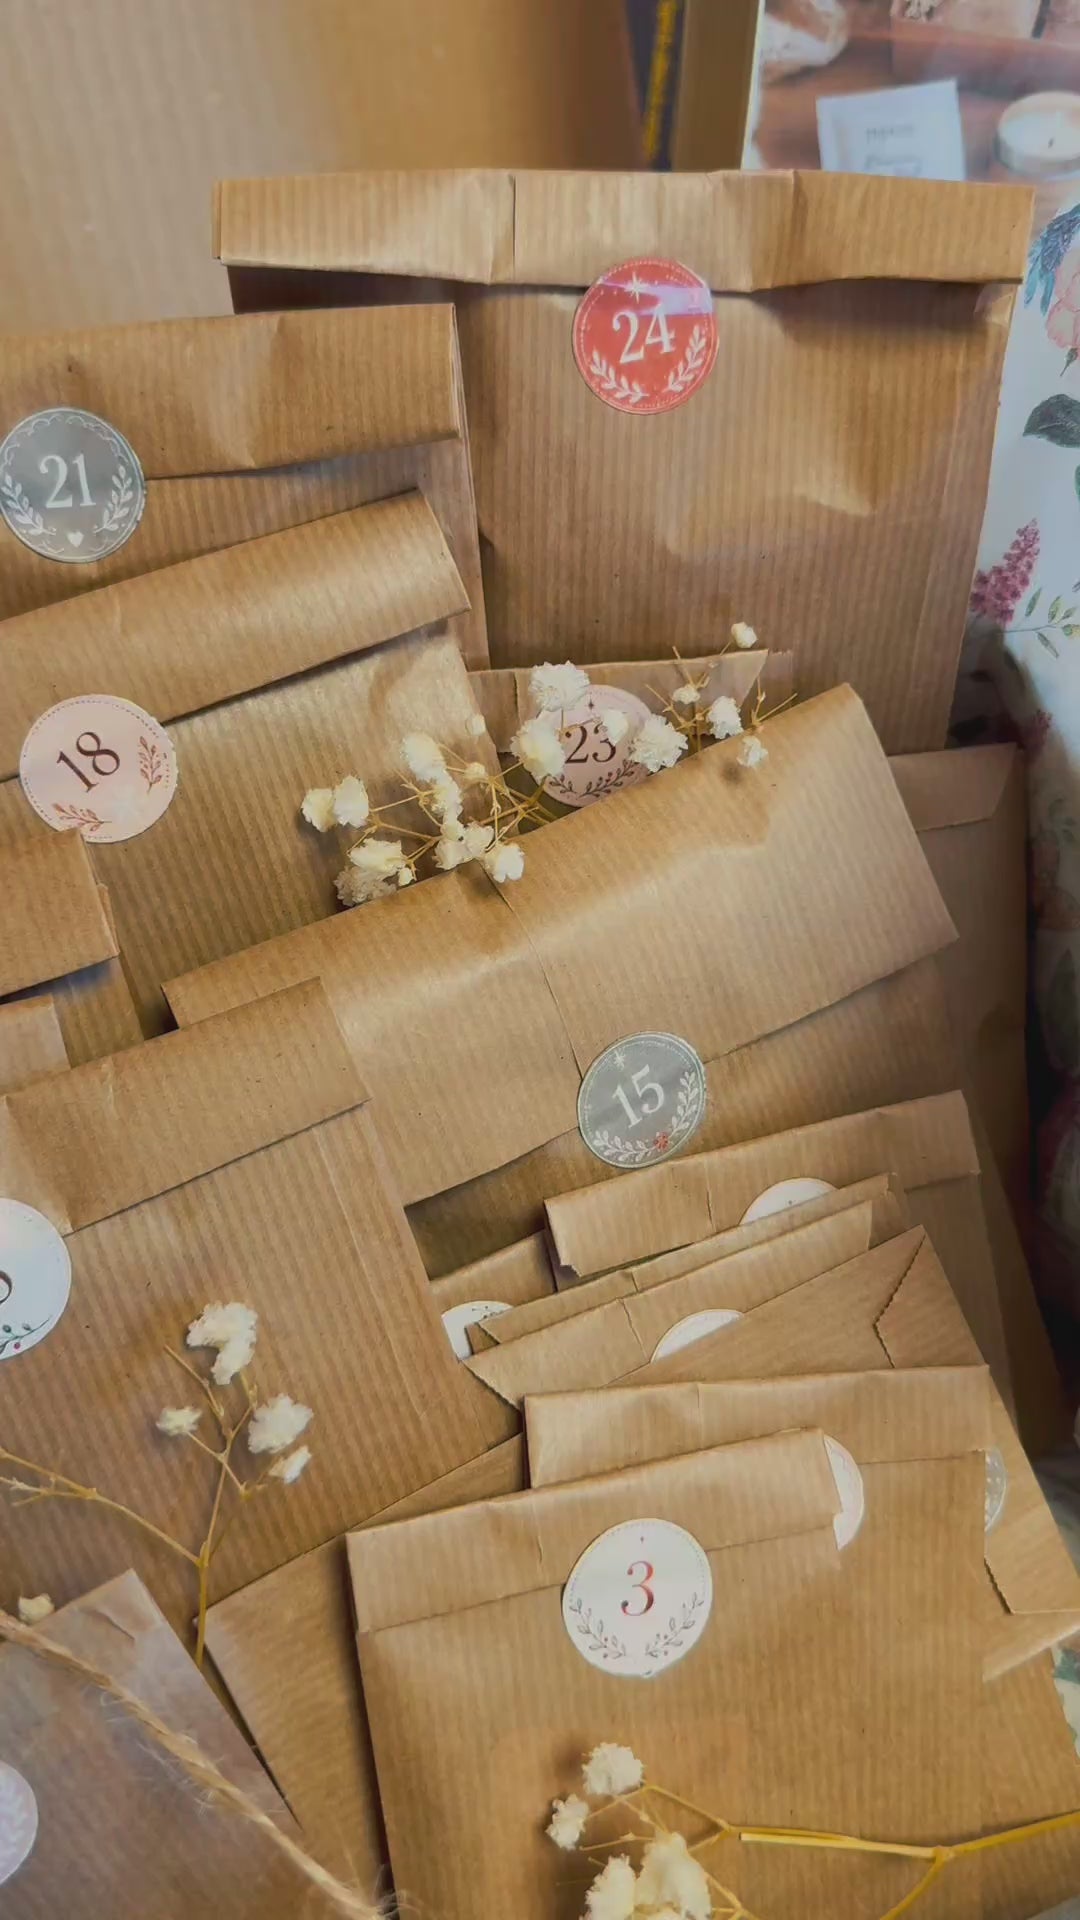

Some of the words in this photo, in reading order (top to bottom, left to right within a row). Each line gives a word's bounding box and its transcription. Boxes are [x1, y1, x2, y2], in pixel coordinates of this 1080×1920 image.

[612, 302, 676, 364] 24
[39, 453, 96, 508] 21
[56, 731, 120, 793] 18
[611, 1064, 664, 1128] 15
[621, 1560, 654, 1616] 3
